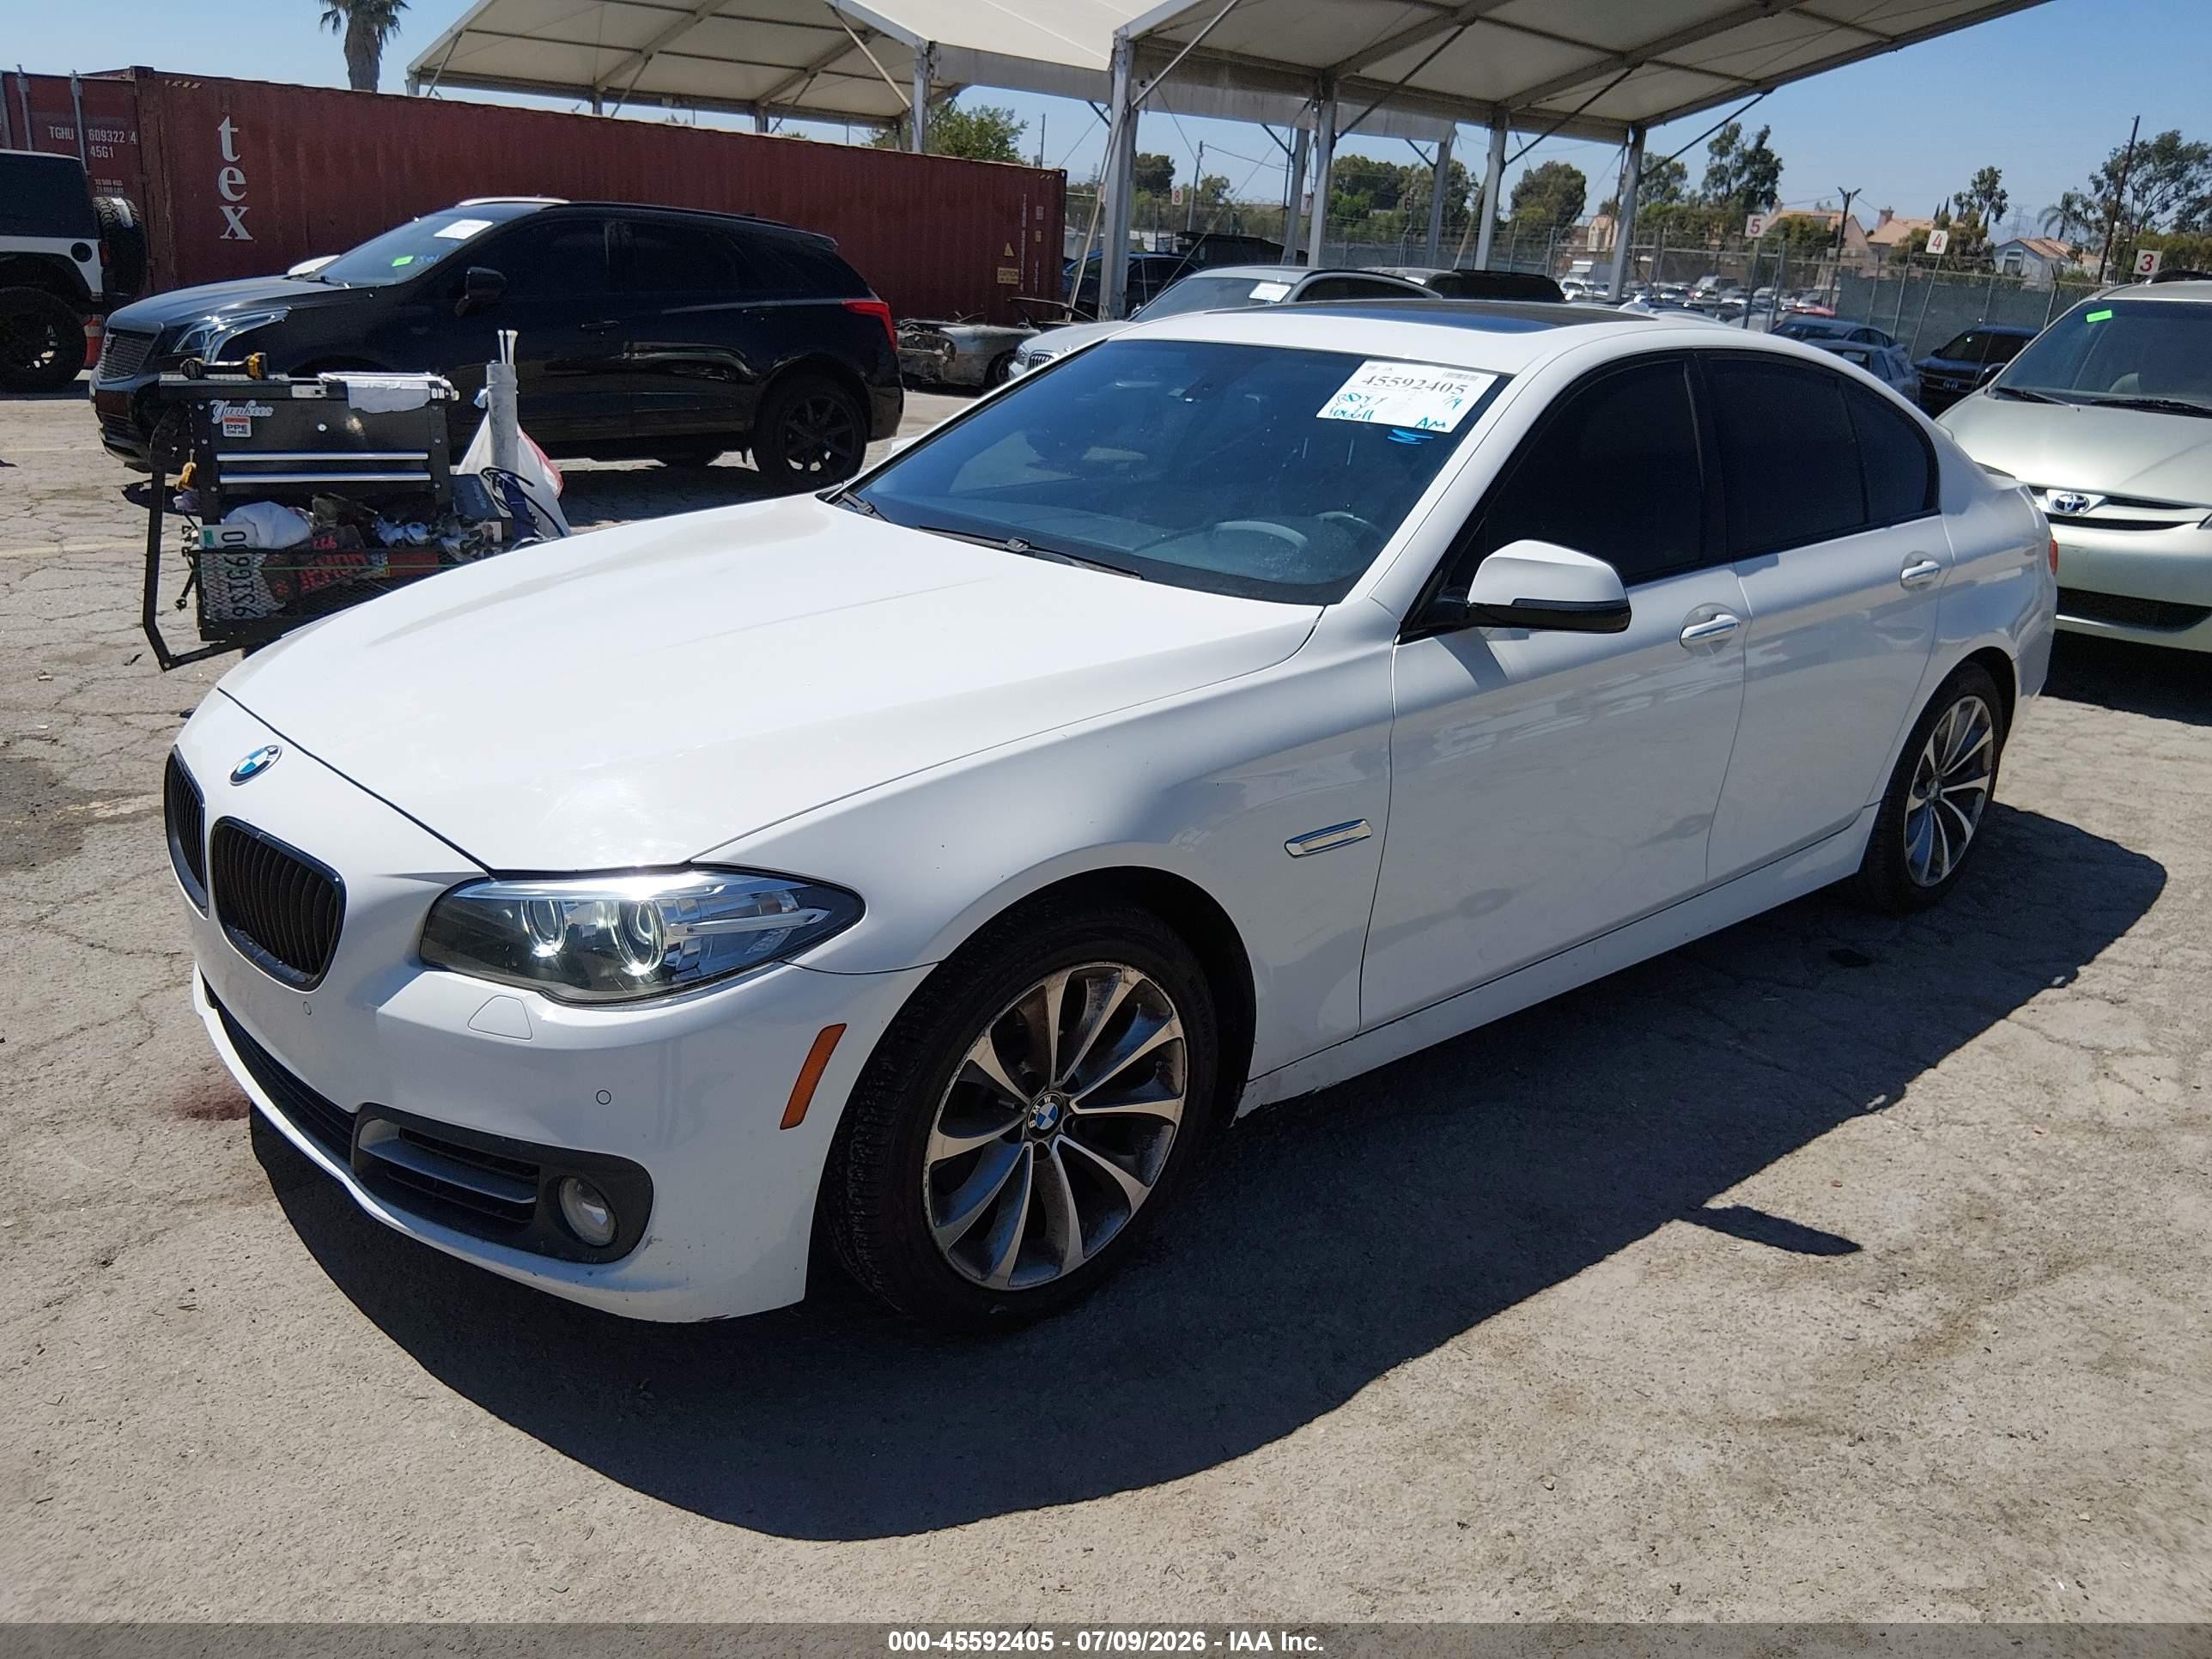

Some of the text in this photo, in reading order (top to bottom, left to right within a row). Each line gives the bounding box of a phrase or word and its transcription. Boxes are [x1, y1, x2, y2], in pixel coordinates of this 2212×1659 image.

[48, 126, 75, 141] TGHU
[88, 129, 126, 144] 609322
[90, 145, 115, 159] 45G1
[217, 116, 254, 240] tex
[1750, 218, 1761, 234] 5
[1932, 233, 1942, 251] 4
[2139, 253, 2154, 272] 3
[1361, 375, 1468, 395] 45592405
[210, 399, 275, 425] Yankees
